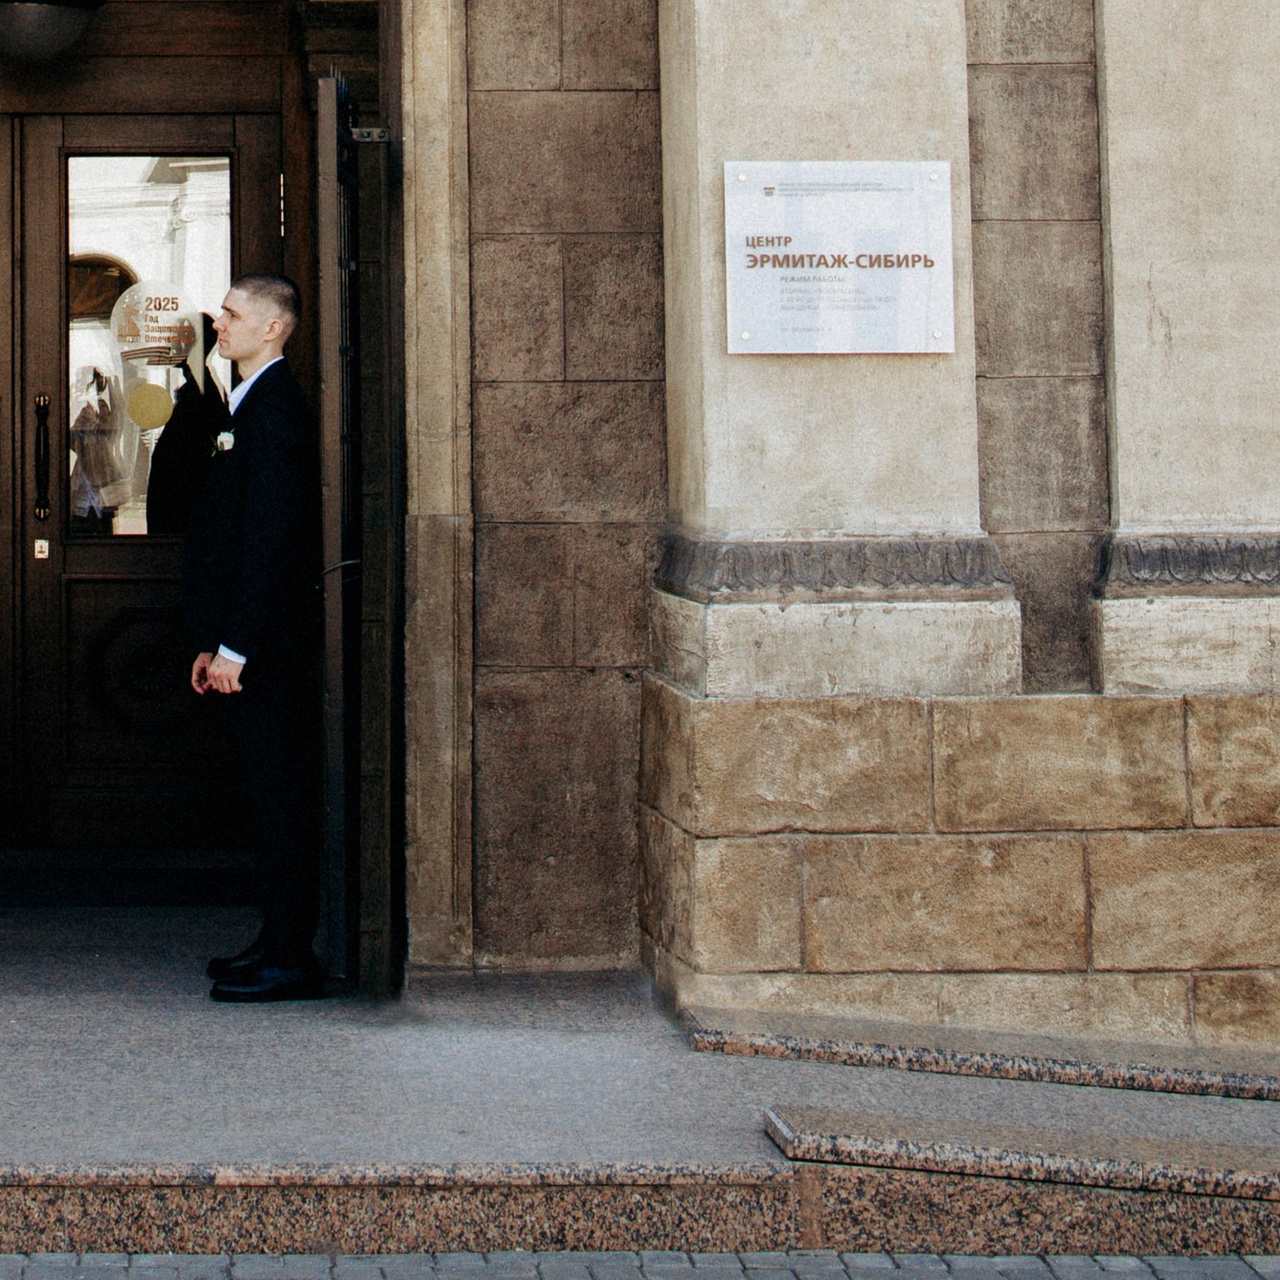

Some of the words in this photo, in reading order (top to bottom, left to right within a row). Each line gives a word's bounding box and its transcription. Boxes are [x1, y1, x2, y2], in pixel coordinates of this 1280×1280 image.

[745, 236, 792, 248] ЦЕНТР
[746, 253, 935, 269] ЭРМИТАЖ-СИБИРЬ
[780, 275, 811, 283] РЕЖИМ
[145, 296, 179, 311] 2025
[144, 314, 159, 323] Год
